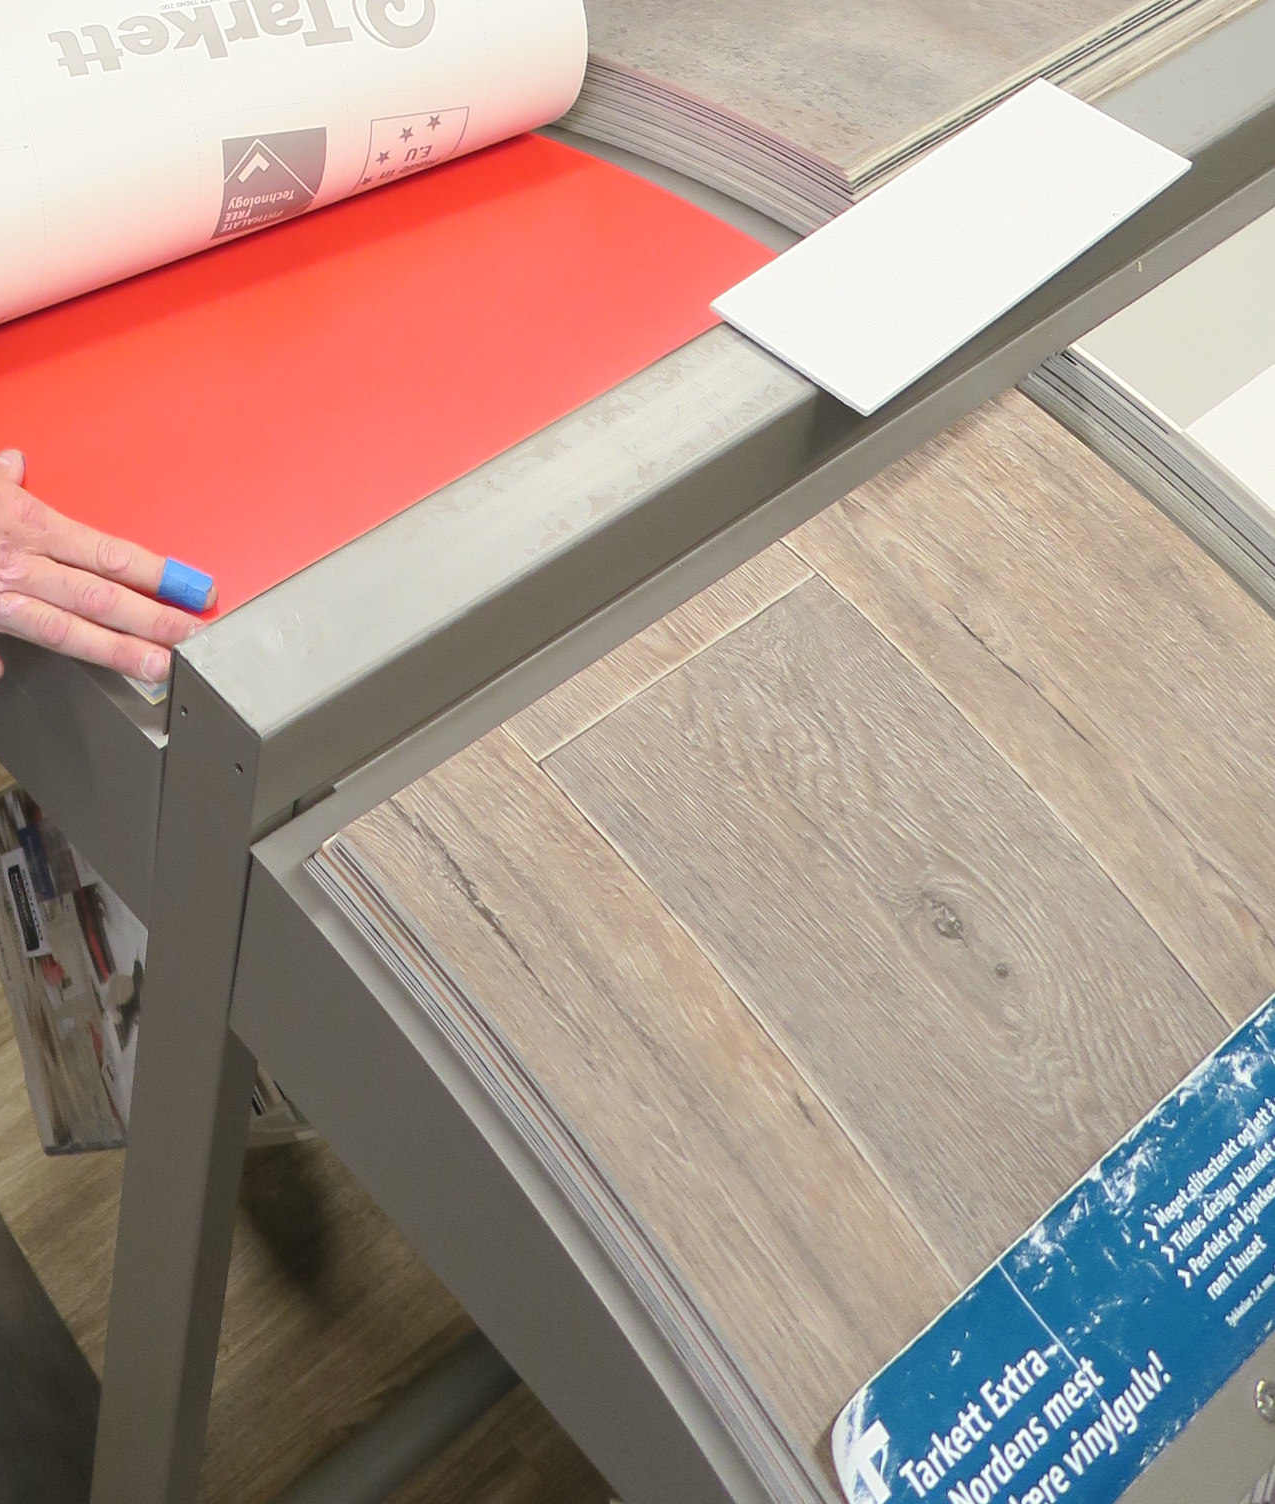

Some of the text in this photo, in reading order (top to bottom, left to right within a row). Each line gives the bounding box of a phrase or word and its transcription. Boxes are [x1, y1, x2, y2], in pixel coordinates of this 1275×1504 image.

[225, 208, 252, 222] FREE
[228, 189, 296, 209] Technology
[1202, 1181, 1239, 1220] design
[1188, 1229, 1232, 1276] Perfekt
[1230, 1233, 1267, 1273] huset
[947, 1355, 1106, 1504] Nordens mest
[1062, 1349, 1172, 1478] vinylgulv!
[897, 1401, 994, 1498] Tarkett
